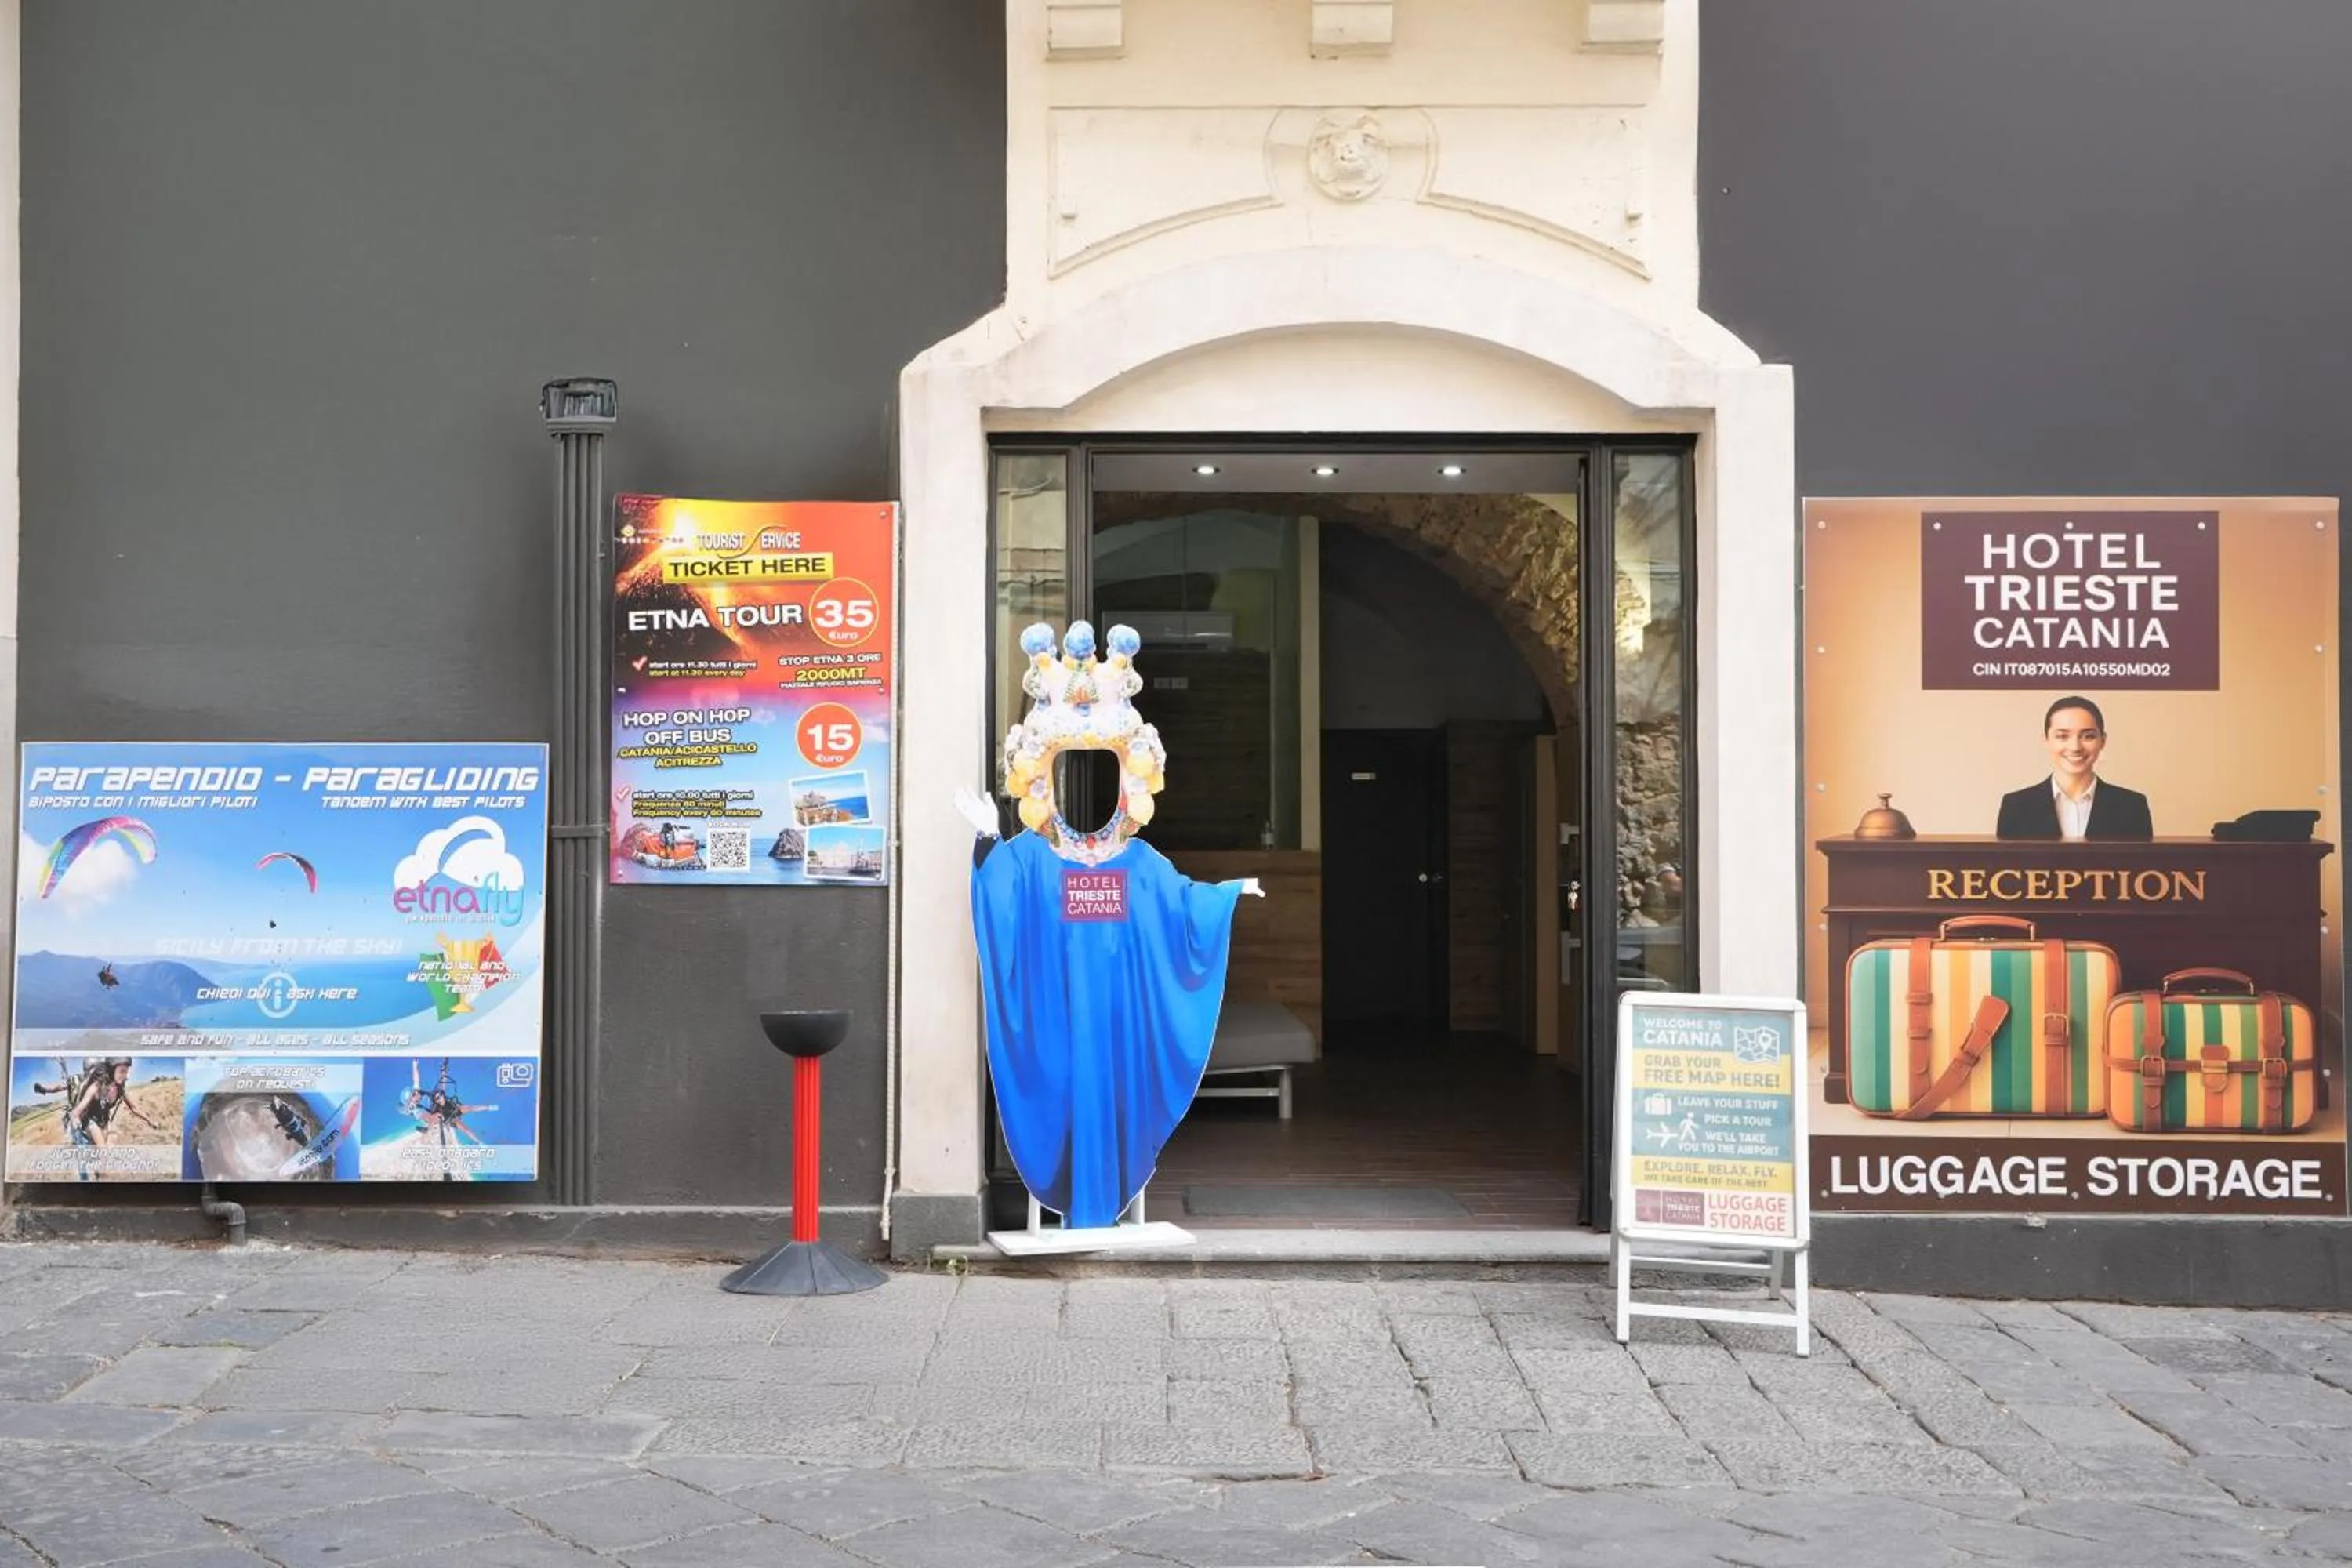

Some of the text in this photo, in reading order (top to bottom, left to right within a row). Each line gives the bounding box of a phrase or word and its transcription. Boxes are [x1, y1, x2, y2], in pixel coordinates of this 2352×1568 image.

[1983, 533, 2161, 569] HOTEL
[670, 557, 826, 577] TICKET HERE
[1964, 575, 2179, 611] TRIESTE
[628, 604, 803, 630] ETNA TOUR
[815, 600, 873, 628] 35
[1973, 617, 2169, 648] CATANIA
[779, 656, 809, 666] STOP
[813, 655, 843, 664] ETNA
[797, 667, 866, 681] 2000MT
[1973, 662, 2170, 677] CIN IT087015A10550MD02
[623, 709, 750, 727] HOP ON HOP
[644, 729, 731, 744] OFF BUS
[807, 724, 854, 751] 15
[655, 757, 721, 767] ACITREZZA
[29, 767, 263, 791] PARAPENDIO
[302, 767, 539, 791] PARAGLIDING
[29, 796, 90, 808] BIPOSTO
[93, 796, 123, 808] CON
[137, 796, 205, 808] MIGLIORI
[210, 796, 257, 808] PILOTI
[321, 796, 525, 808] TANDEM WITH BEST PILOTS
[728, 791, 753, 800] giorni
[633, 809, 681, 818] Frequency
[683, 809, 707, 818] every
[1067, 877, 1120, 888] HOTEL
[1926, 869, 2206, 902] RECEPTION
[394, 872, 524, 927] etnafly
[1067, 890, 1121, 901] TRIESTE
[1067, 902, 1122, 914] CATANIA
[299, 938, 347, 954] THE
[406, 972, 451, 982] WORLD
[197, 988, 243, 1000] CHIEDI
[286, 988, 314, 1000] ASK
[318, 988, 358, 1000] HERE
[1644, 1018, 1722, 1030] WELCOME TO
[177, 1034, 204, 1045] AND
[322, 1034, 347, 1045] ALL
[351, 1034, 410, 1045] SEASONS
[1643, 1029, 1724, 1047] CATANIA
[1645, 1054, 1721, 1068] GRAB YOUR
[1645, 1069, 1780, 1088] FREE MAP HERE!
[1678, 1097, 1779, 1110] LEAVE YOUR STUFF
[1704, 1114, 1772, 1127] PICK A TOUR
[1738, 1133, 1766, 1143] TAKE
[1678, 1142, 1780, 1156] YOU TO THE AIRPORT
[1644, 1160, 1704, 1174] EXPLORE.
[1685, 1176, 1708, 1185] CARE
[1831, 1156, 2321, 1198] LUGGAGE STORAGE
[1708, 1194, 1788, 1213] LUGGAGE
[1710, 1213, 1786, 1231] STORAGE
